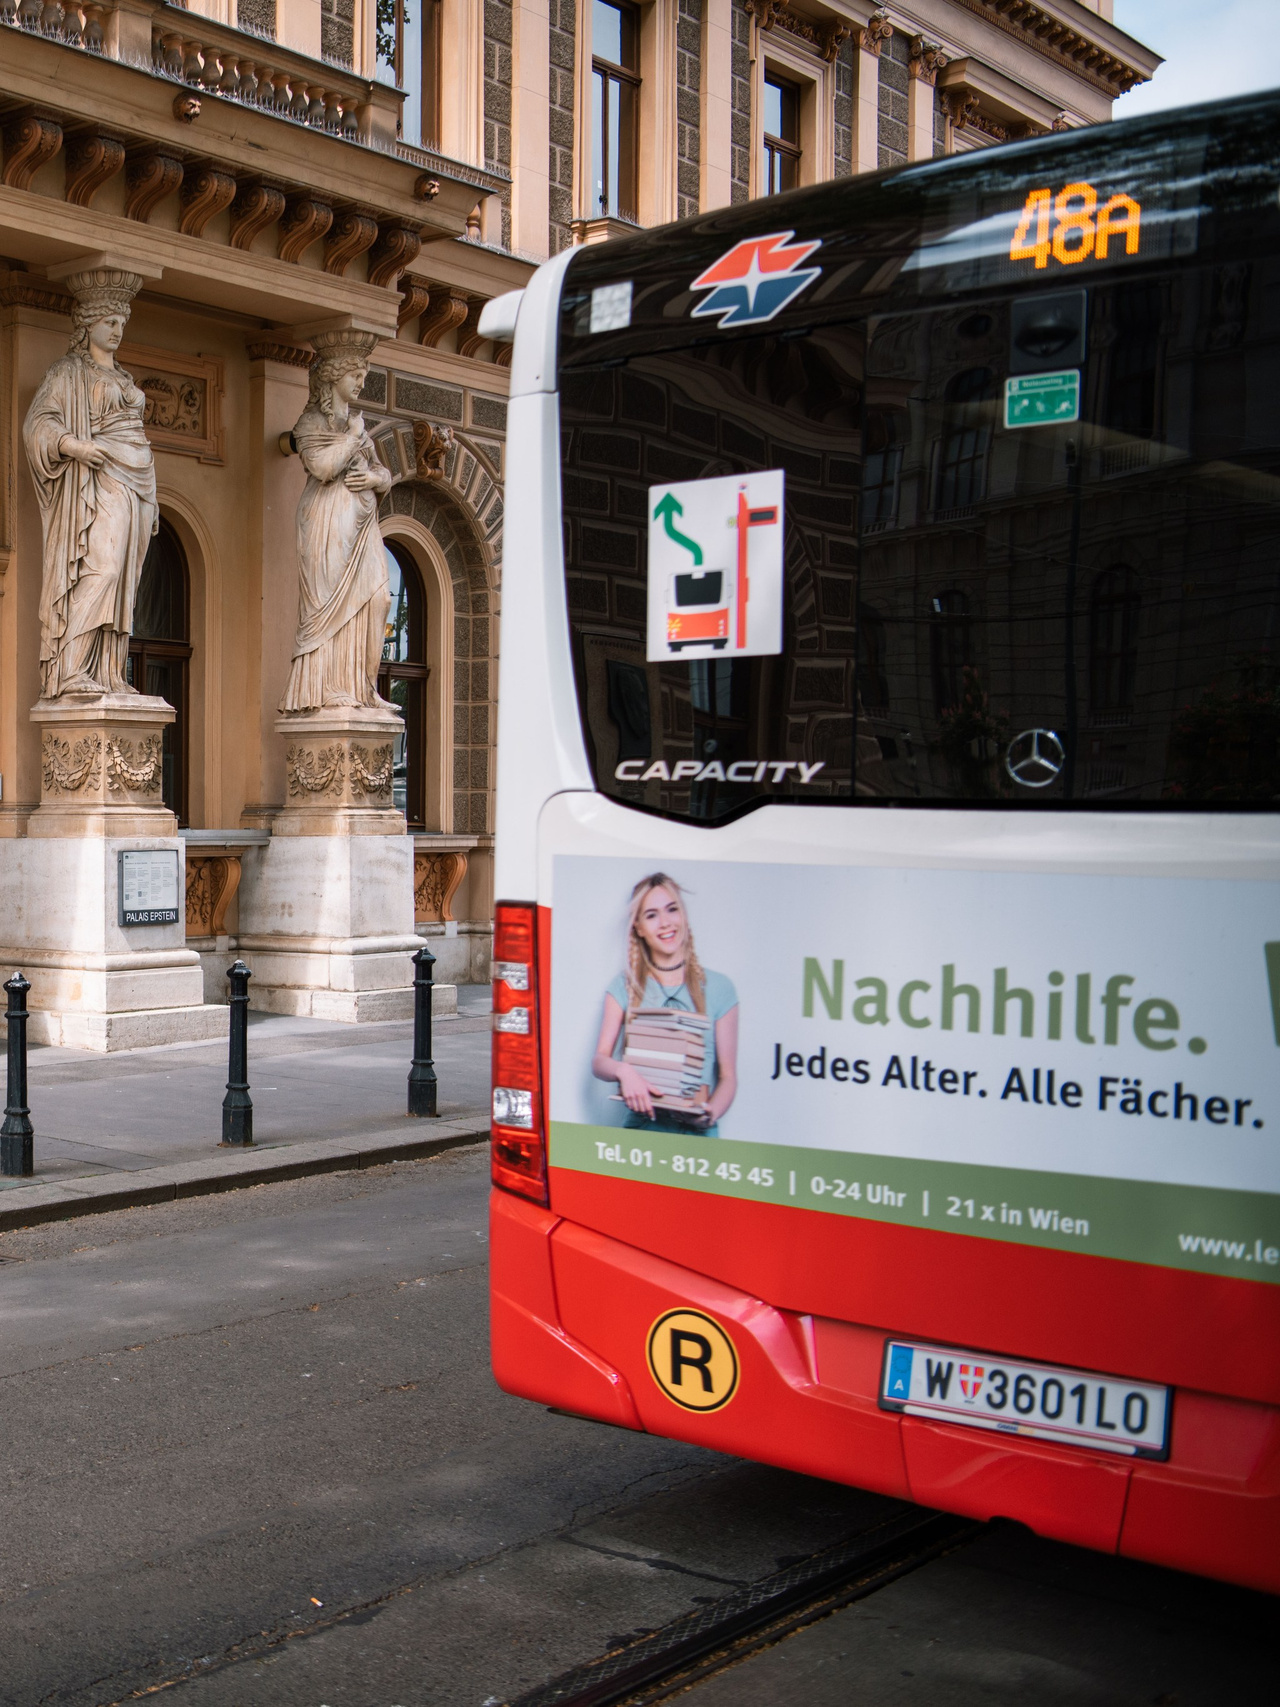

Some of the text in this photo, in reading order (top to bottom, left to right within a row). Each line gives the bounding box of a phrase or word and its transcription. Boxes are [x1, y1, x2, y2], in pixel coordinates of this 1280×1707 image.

[1010, 181, 1141, 269] 48A
[614, 760, 825, 784] CAPACITY
[126, 911, 176, 922] PALAIS EPSTEIN
[801, 956, 1208, 1055] Nachhilfe.
[771, 1043, 1264, 1129] Jedes Alter. Alle Fächer.
[595, 1141, 626, 1163] Tel.
[629, 1148, 653, 1167] 01
[672, 1154, 710, 1177] 812
[715, 1162, 742, 1182] 45
[747, 1167, 774, 1187] 45
[810, 1176, 862, 1200] 0-24
[866, 1183, 907, 1208] Uhr
[946, 1196, 974, 1218] 21
[980, 1205, 995, 1222] x
[1000, 1202, 1023, 1226] in
[1028, 1207, 1090, 1236] Wien
[1178, 1234, 1280, 1265] www.le
[670, 1328, 714, 1393] R
[893, 1379, 904, 1391] A
[926, 1358, 953, 1400] W
